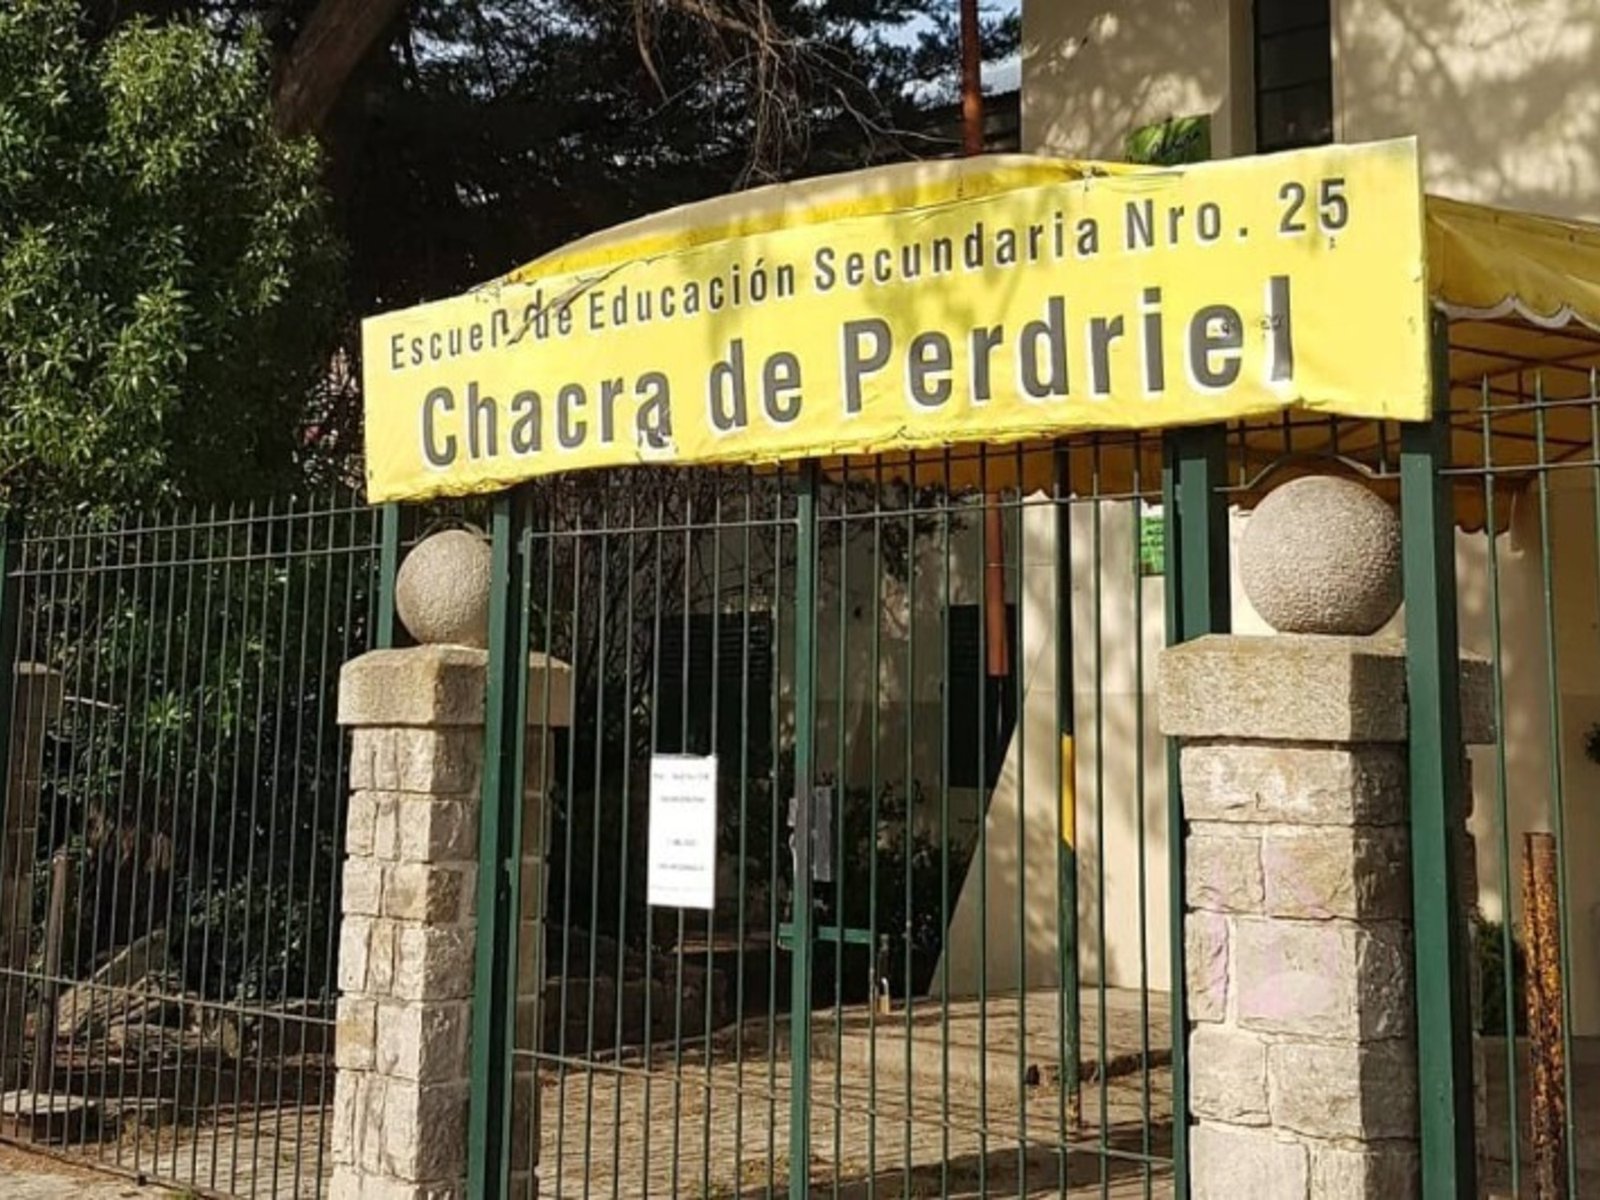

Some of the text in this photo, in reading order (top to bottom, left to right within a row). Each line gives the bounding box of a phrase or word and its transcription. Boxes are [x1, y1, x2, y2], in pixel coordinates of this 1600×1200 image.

[590, 258, 794, 329] Educación
[815, 210, 1099, 291] Secundaria
[1126, 199, 1249, 249] Nro.
[1279, 178, 1348, 233] 25
[422, 274, 1294, 467] Chacra de Perdriel
